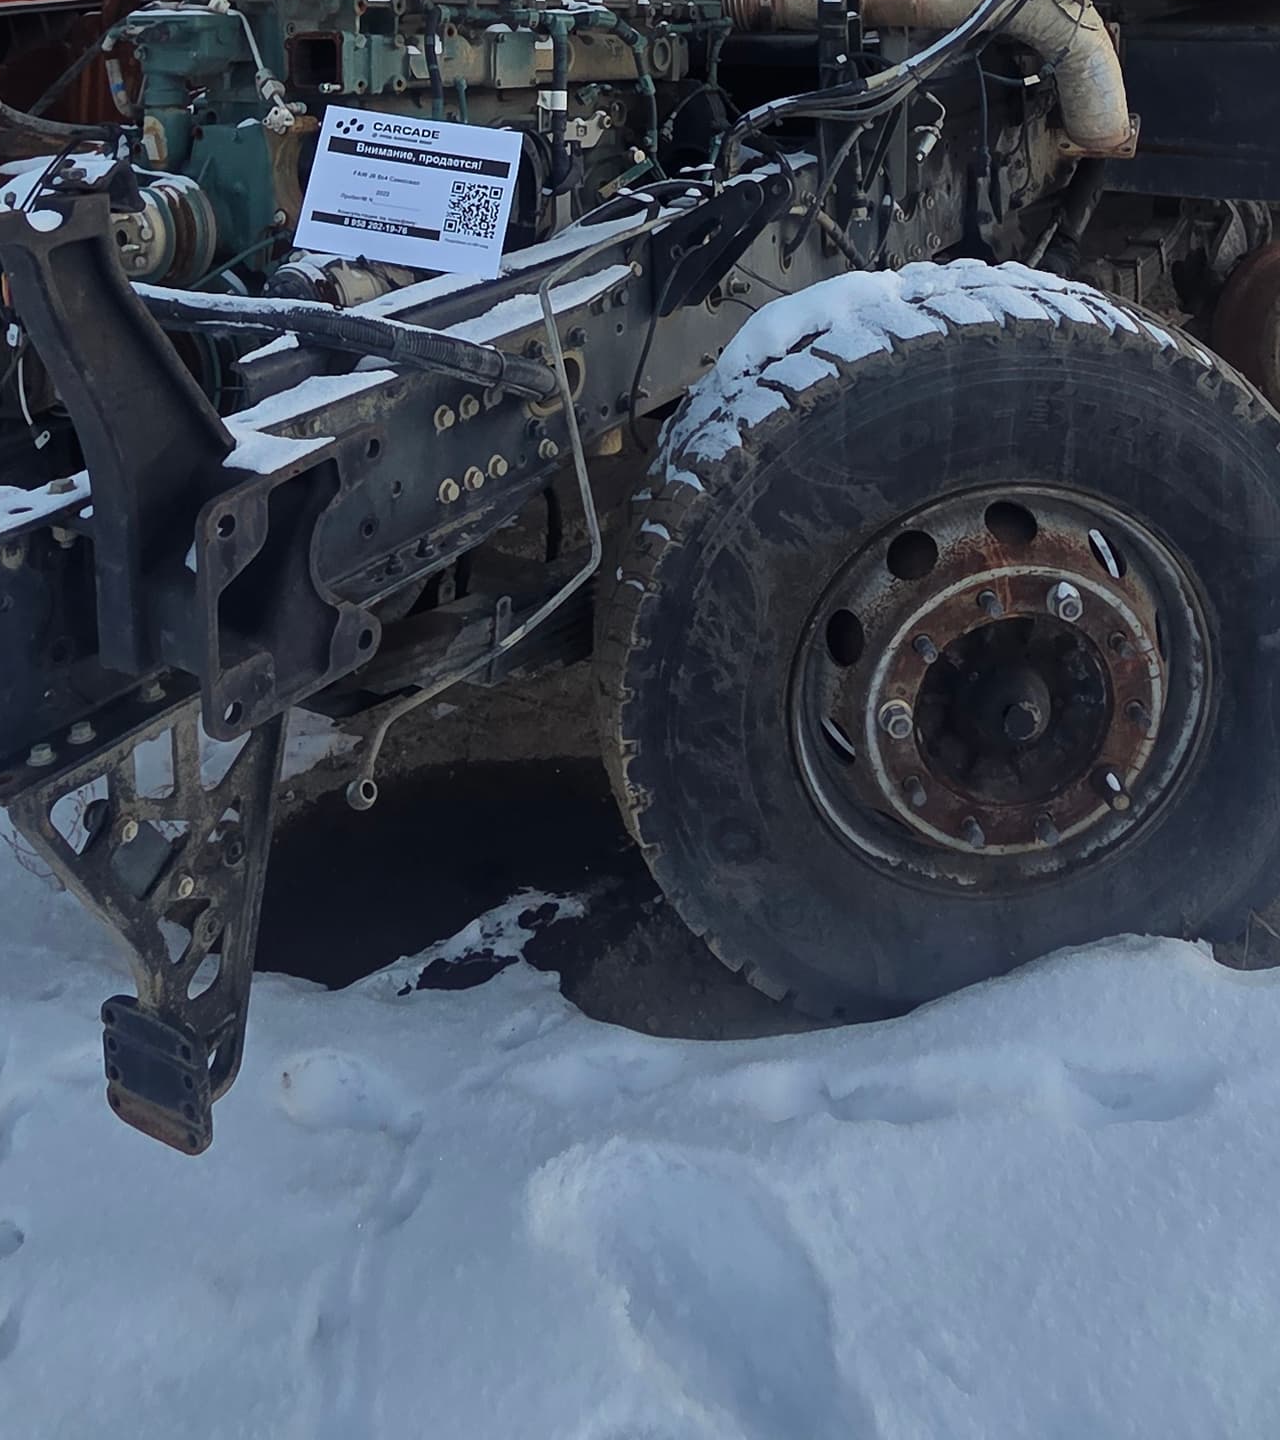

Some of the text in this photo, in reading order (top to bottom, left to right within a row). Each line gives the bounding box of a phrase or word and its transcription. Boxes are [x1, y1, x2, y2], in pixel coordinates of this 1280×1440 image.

[373, 122, 440, 140] CARCADE
[356, 142, 483, 171] Внимание, продается!
